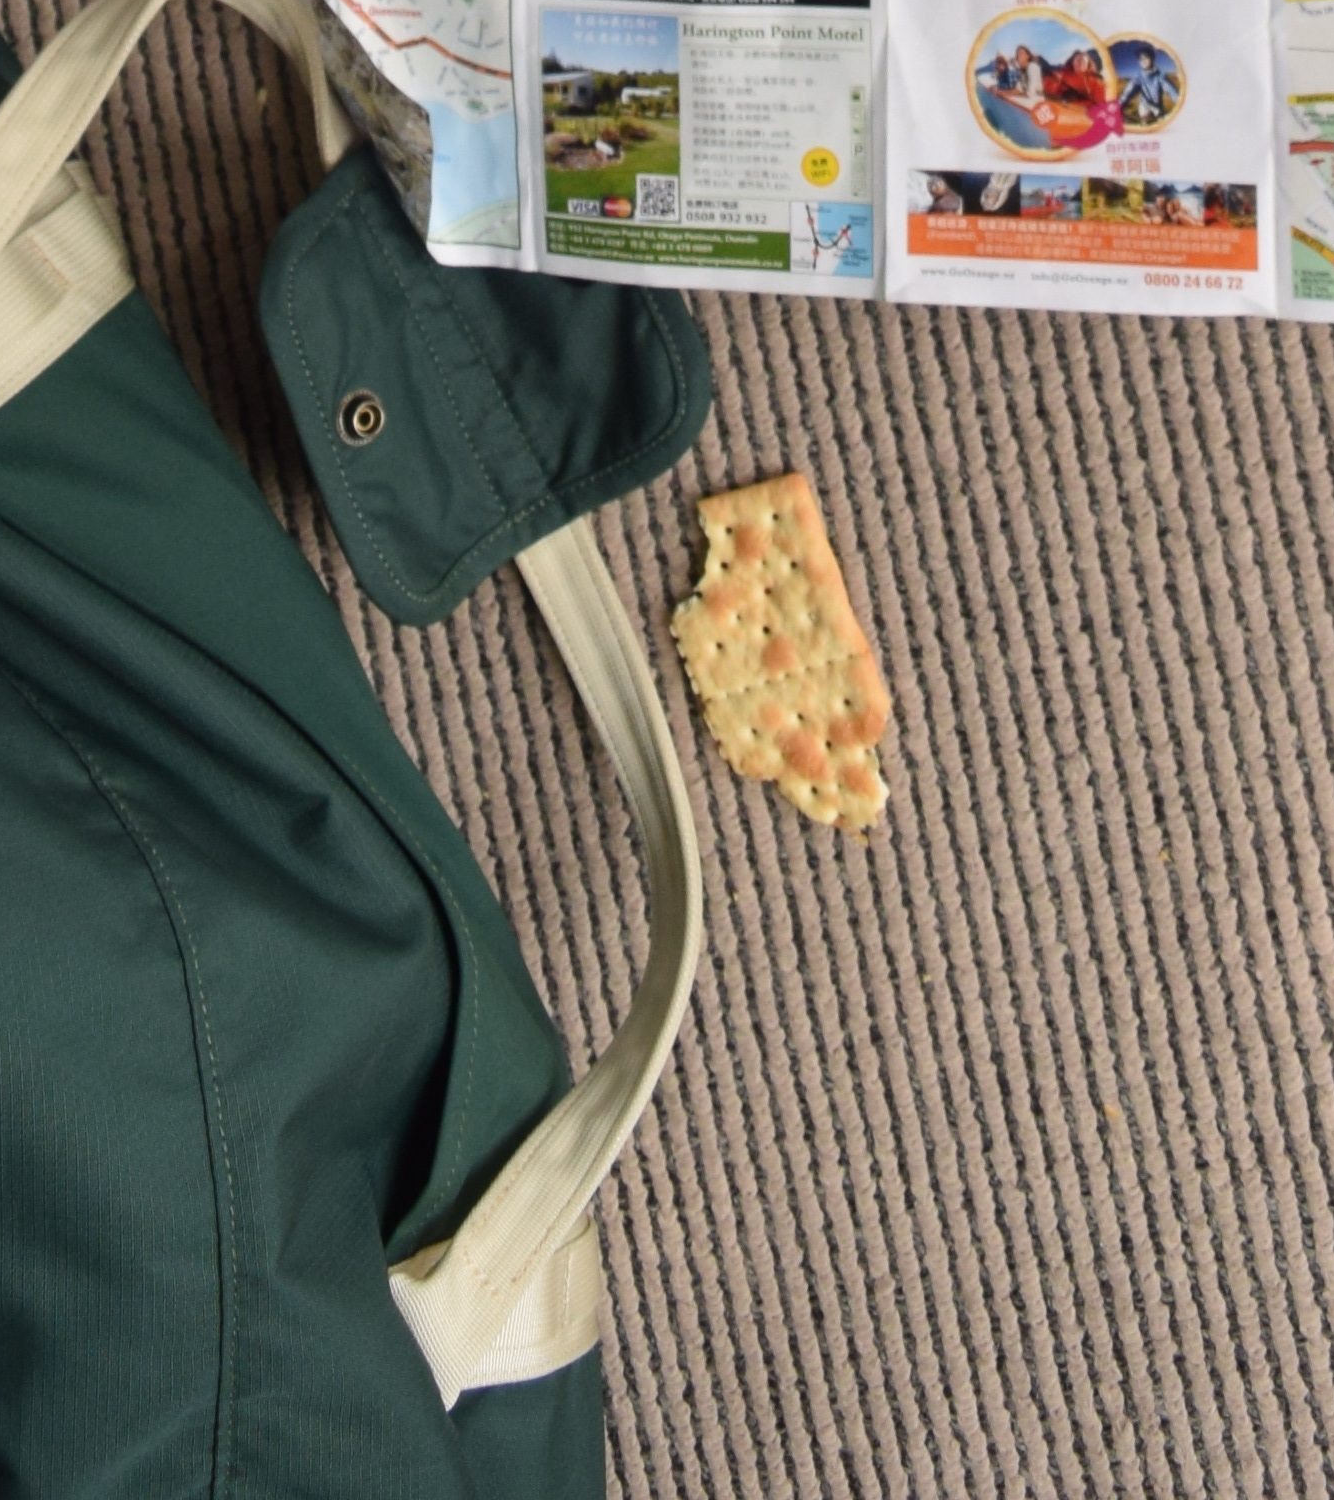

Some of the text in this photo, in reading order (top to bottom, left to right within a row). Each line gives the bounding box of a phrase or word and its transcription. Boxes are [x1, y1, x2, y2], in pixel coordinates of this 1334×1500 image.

[681, 22, 767, 42] Harington
[770, 24, 813, 42] Point
[816, 25, 865, 43] Motel
[570, 201, 599, 215] VISA
[685, 211, 768, 225] 0508 932 932
[1144, 272, 1180, 288] 0800
[1183, 273, 1202, 288] 24
[1204, 274, 1223, 289] 66
[1226, 275, 1245, 290] 72
